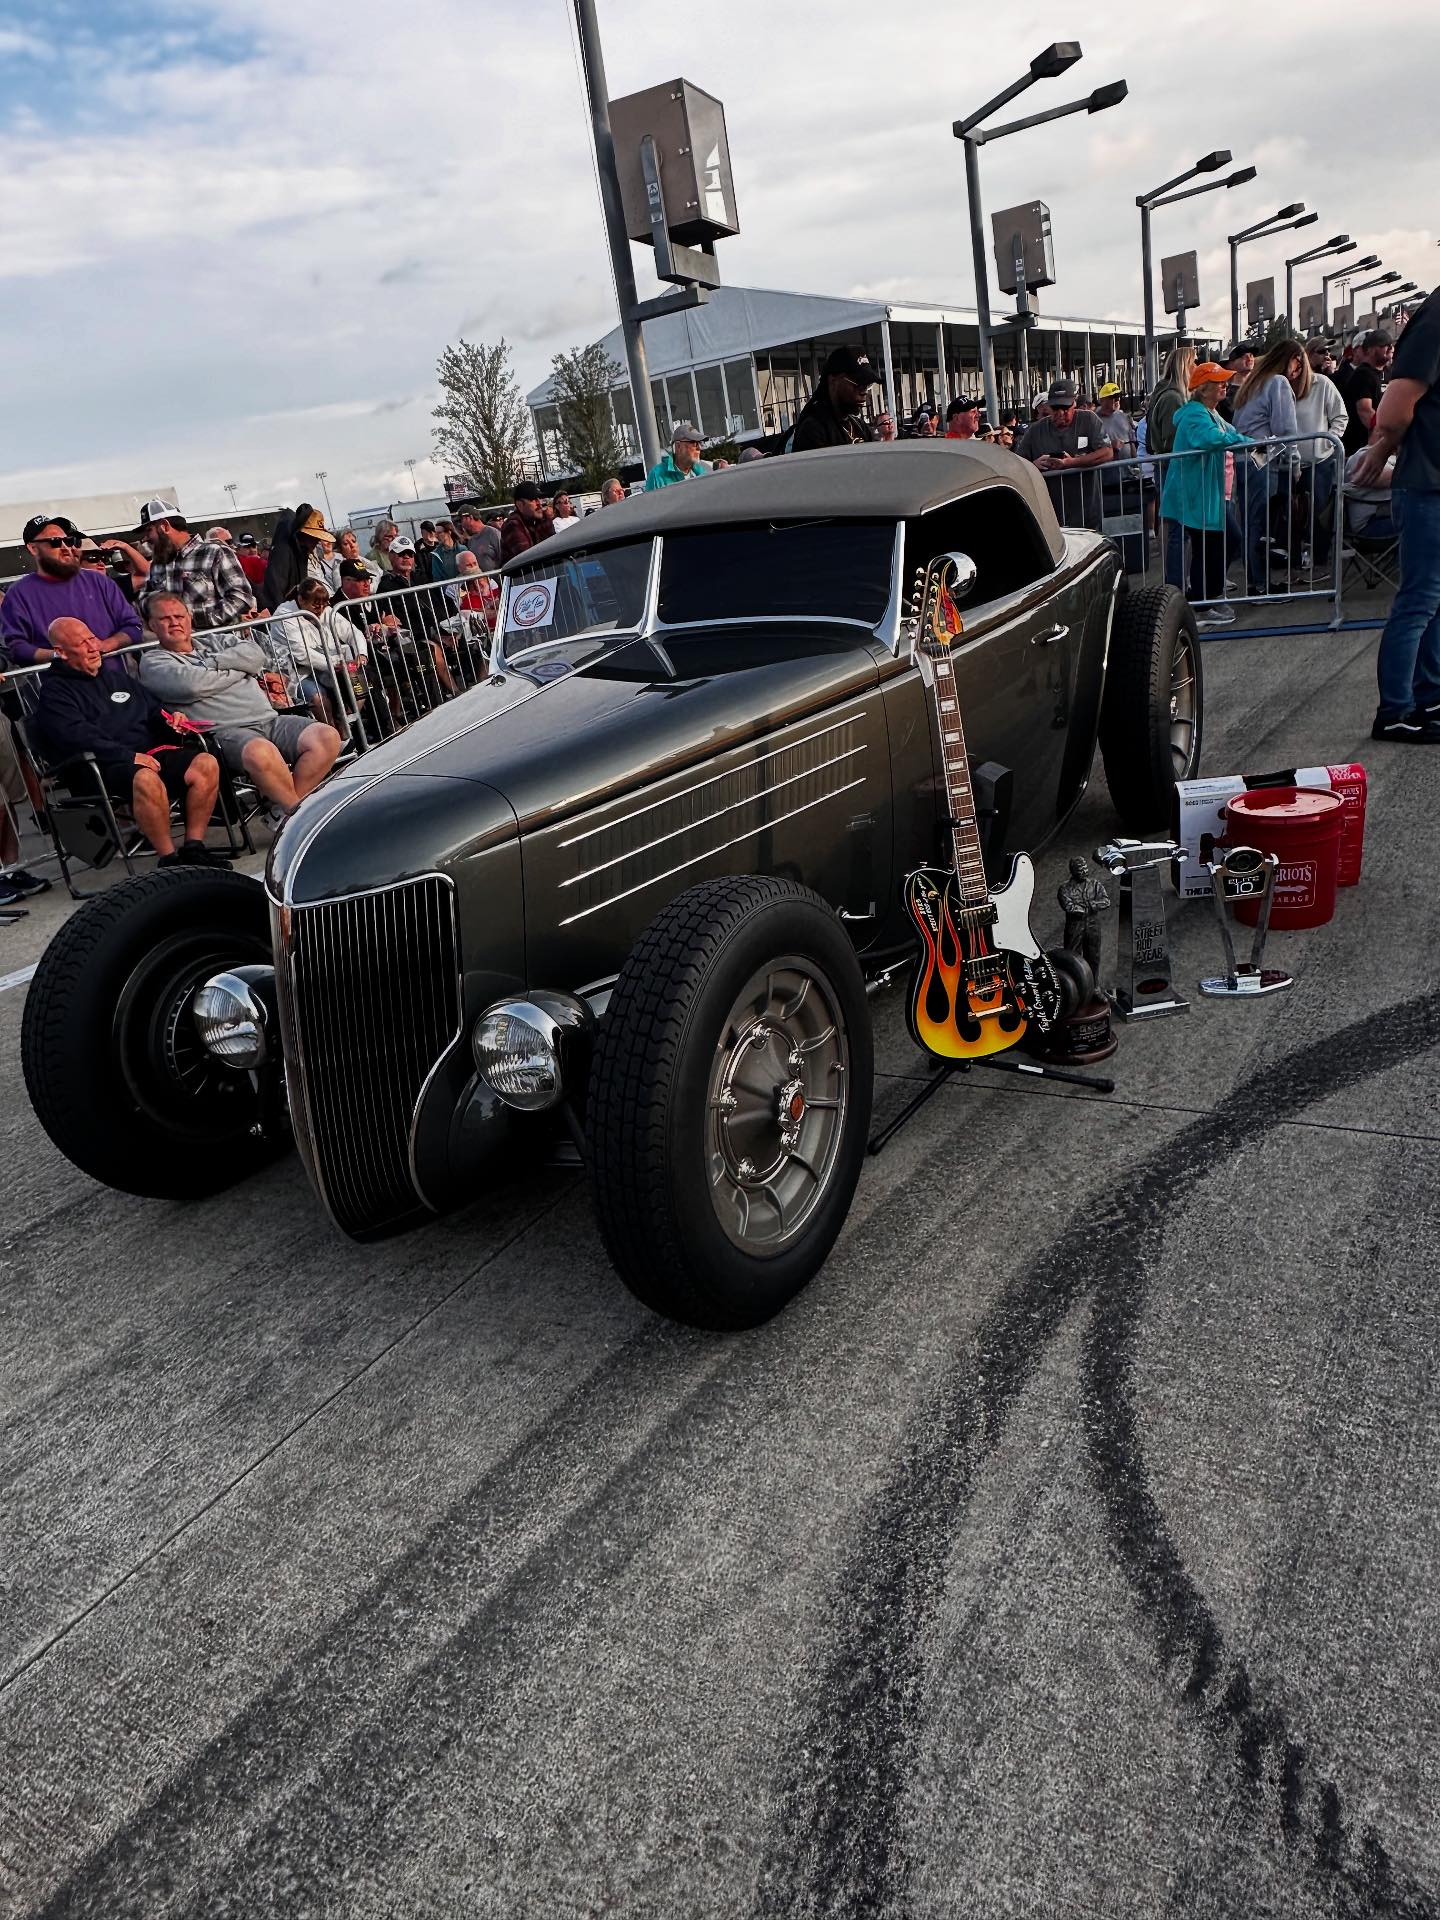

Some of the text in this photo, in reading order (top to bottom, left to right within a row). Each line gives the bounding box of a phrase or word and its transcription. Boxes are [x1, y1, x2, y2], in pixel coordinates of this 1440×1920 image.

[1235, 881, 1254, 894] 10
[1135, 925, 1164, 940] STREET
[1136, 938, 1153, 951] ROD
[1143, 947, 1163, 962] YEAR
